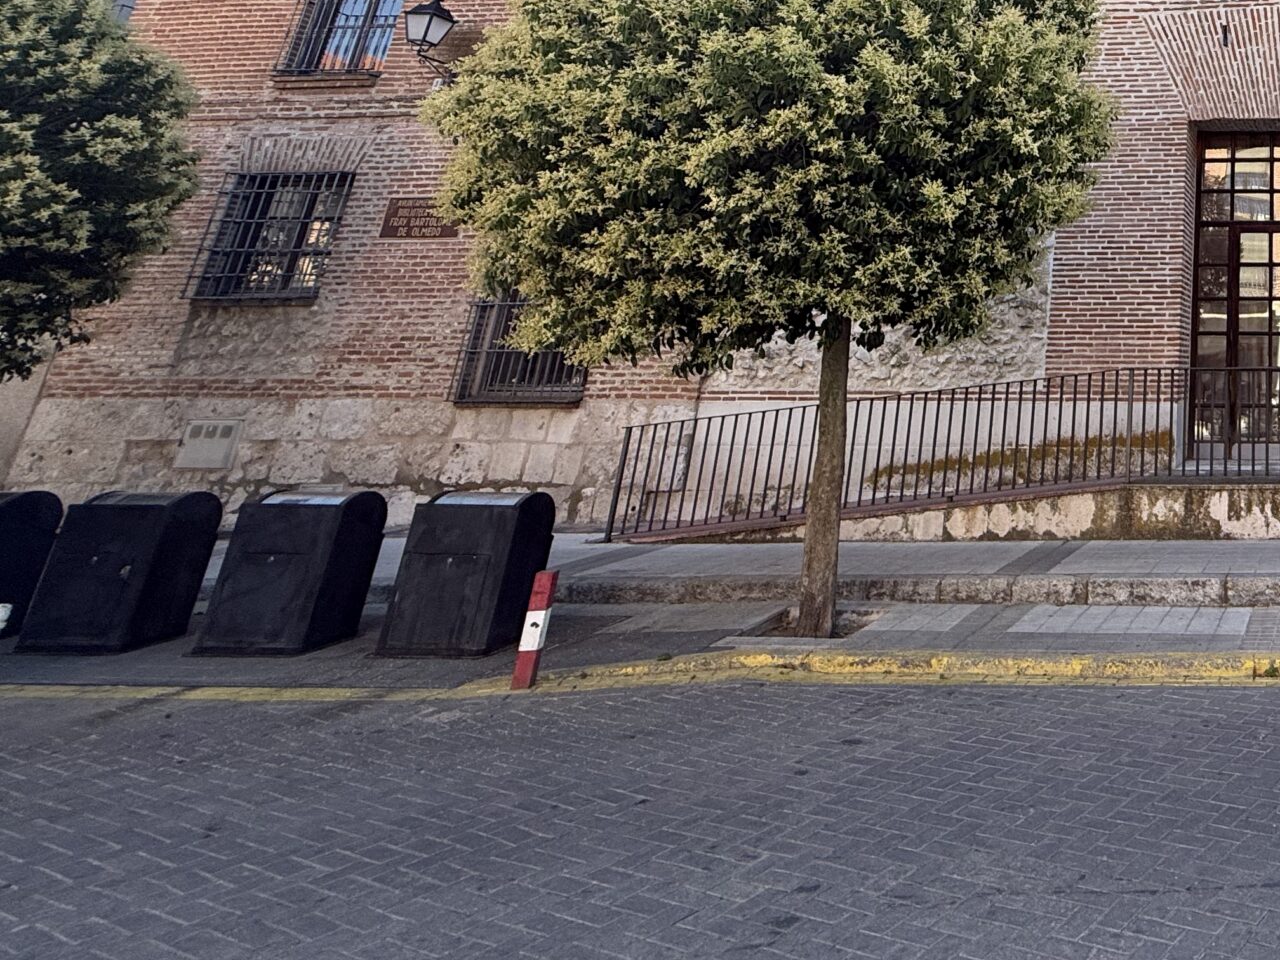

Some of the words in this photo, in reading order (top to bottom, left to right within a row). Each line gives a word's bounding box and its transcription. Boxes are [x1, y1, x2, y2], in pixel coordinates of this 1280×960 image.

[389, 217, 407, 226] FRAY
[397, 227, 408, 236] DE
[411, 227, 442, 236] OLMEDO
